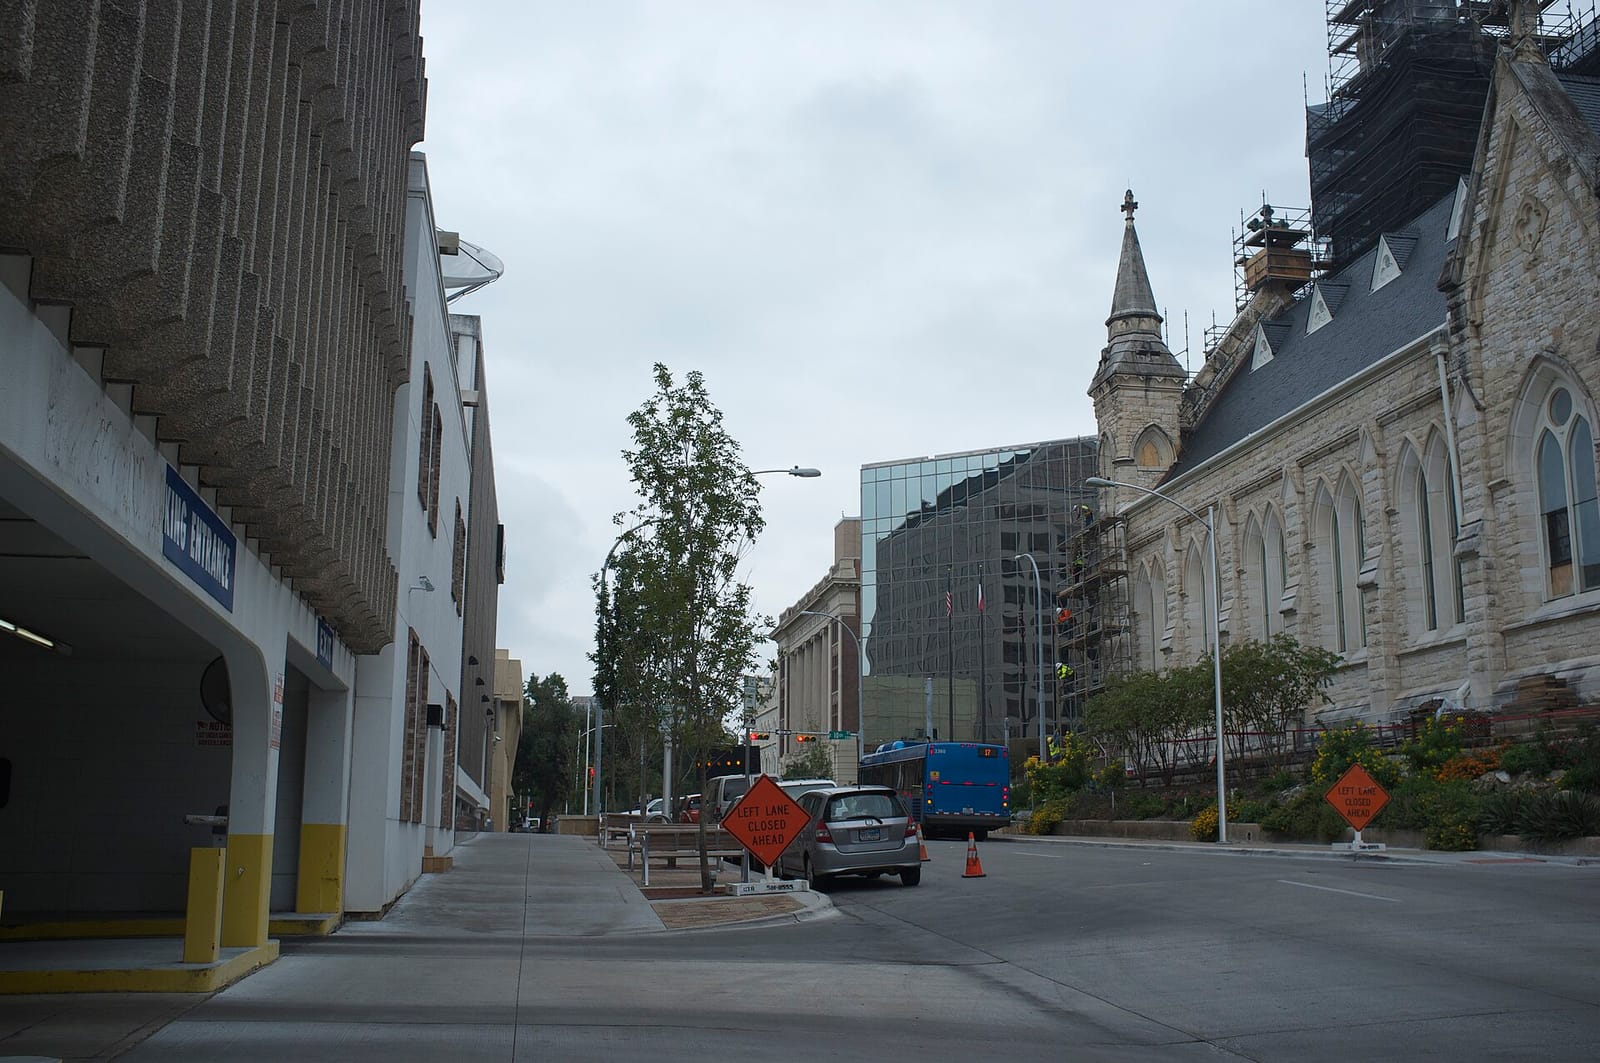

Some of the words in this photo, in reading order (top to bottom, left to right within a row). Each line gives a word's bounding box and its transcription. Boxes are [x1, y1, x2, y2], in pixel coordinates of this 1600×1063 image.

[190, 511, 230, 590] ENTRANCE
[319, 627, 331, 664] EXIT
[1338, 786, 1354, 795] LEFT
[1359, 786, 1377, 796] LANE
[1345, 798, 1371, 806] CLOSED
[737, 806, 759, 818] LEFT
[765, 804, 789, 816] LANE
[1347, 809, 1370, 817] AHEAD
[748, 819, 786, 832] CLOSED
[752, 833, 784, 846] AHEAD
